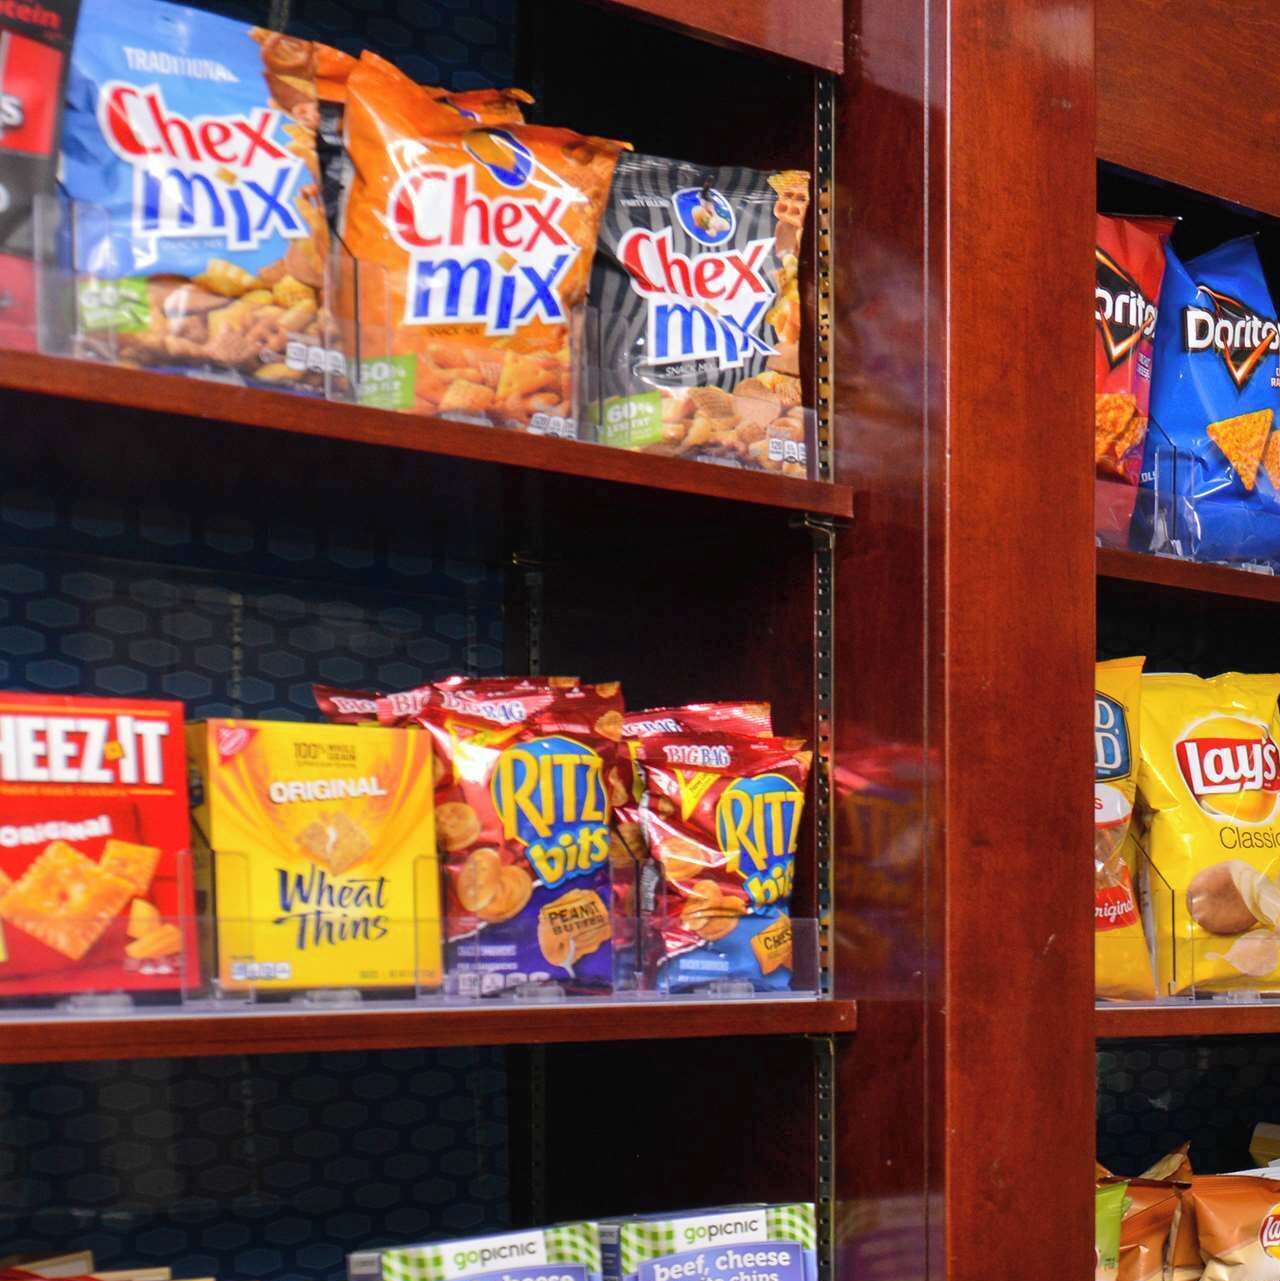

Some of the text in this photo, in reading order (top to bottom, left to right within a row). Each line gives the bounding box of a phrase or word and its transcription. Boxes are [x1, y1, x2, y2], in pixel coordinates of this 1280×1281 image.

[105, 86, 288, 168] Chex
[140, 166, 300, 244] mix
[392, 170, 574, 253] Chex
[412, 253, 570, 331] mix
[621, 231, 769, 300] Chex
[653, 299, 780, 363] mix
[484, 701, 526, 722] BAG
[666, 744, 731, 767] BIG BAG
[1183, 739, 1279, 796] Lay's
[269, 776, 388, 805] ORIGINAL
[498, 750, 606, 848] RITZ
[529, 824, 611, 884] bits
[275, 866, 390, 914] Wheat
[273, 911, 390, 952] Thins
[453, 1238, 538, 1271] gopicnic
[684, 1218, 760, 1244] gopicnic
[715, 1249, 792, 1274] cheese
